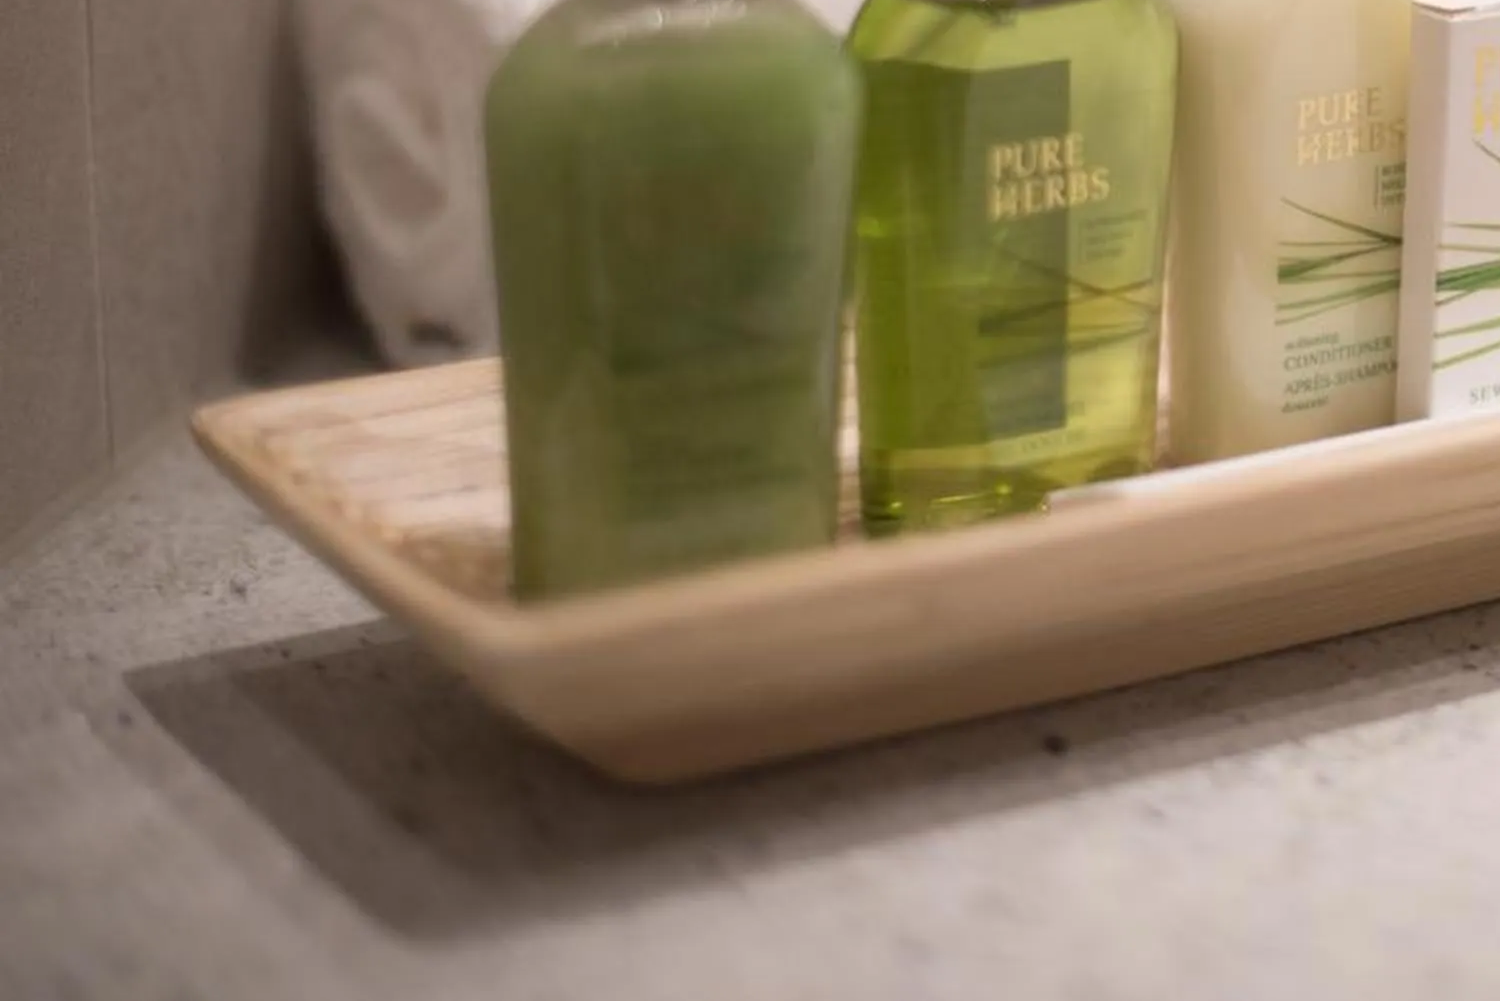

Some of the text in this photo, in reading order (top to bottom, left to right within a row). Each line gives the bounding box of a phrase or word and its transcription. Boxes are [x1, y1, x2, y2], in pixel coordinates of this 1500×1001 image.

[1298, 85, 1382, 131] PURE
[987, 131, 1084, 180] PURE
[986, 166, 1111, 222] HERBS
[1284, 334, 1395, 372] CONDITIONER
